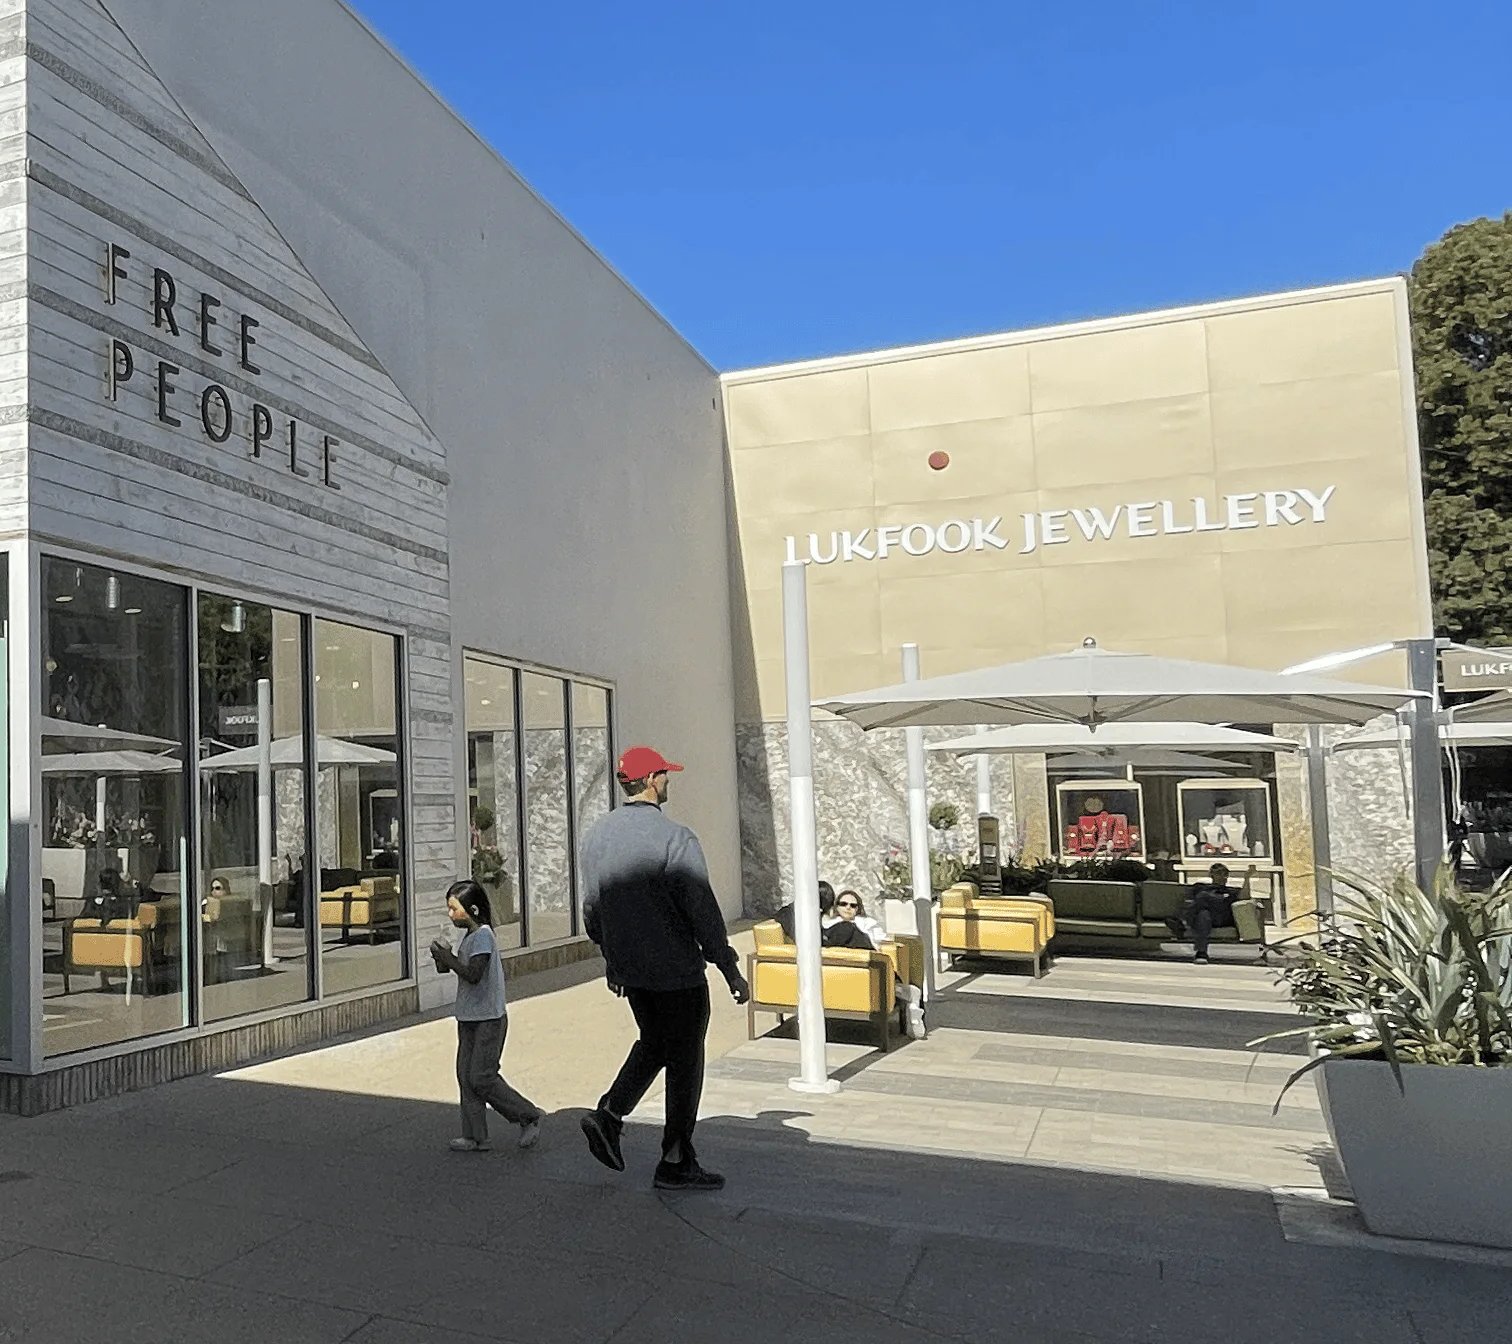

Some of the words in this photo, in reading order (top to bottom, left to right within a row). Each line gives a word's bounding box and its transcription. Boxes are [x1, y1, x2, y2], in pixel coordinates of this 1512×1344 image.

[107, 241, 262, 376] FREE
[108, 336, 342, 491] PEOPLE
[784, 515, 1010, 566] LUKFOOK
[1018, 485, 1336, 555] JEWELLERY
[1460, 662, 1512, 677] LUKF
